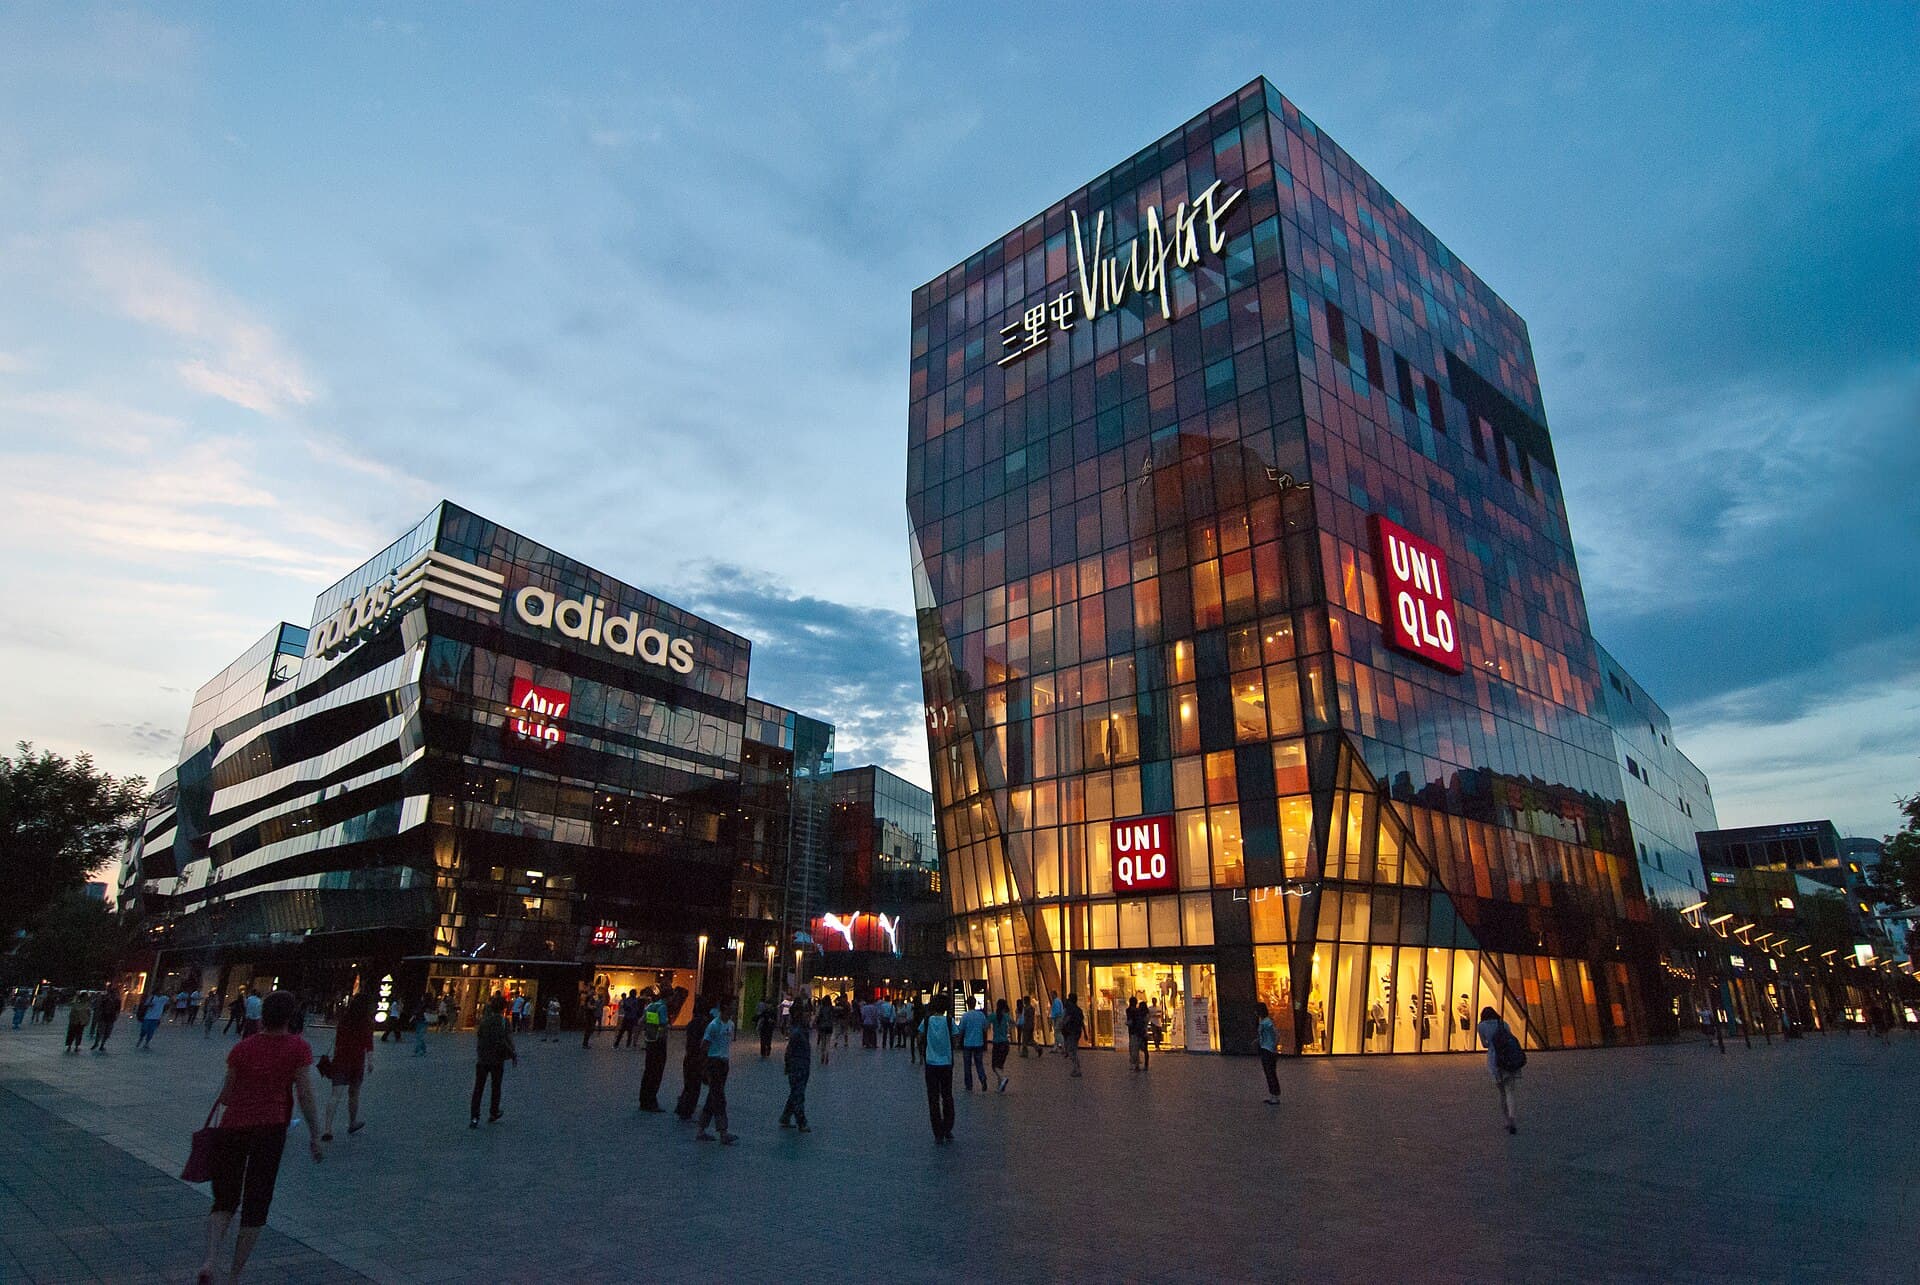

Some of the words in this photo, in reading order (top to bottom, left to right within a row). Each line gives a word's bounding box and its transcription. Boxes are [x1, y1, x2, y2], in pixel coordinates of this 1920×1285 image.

[997, 290, 1075, 365] 三里屯
[1388, 535, 1443, 600] UNI
[313, 579, 393, 658] adidas
[515, 586, 695, 675] adidas
[1398, 592, 1454, 653] QLO
[1117, 823, 1160, 852] UNI
[1118, 853, 1166, 885] QLO
